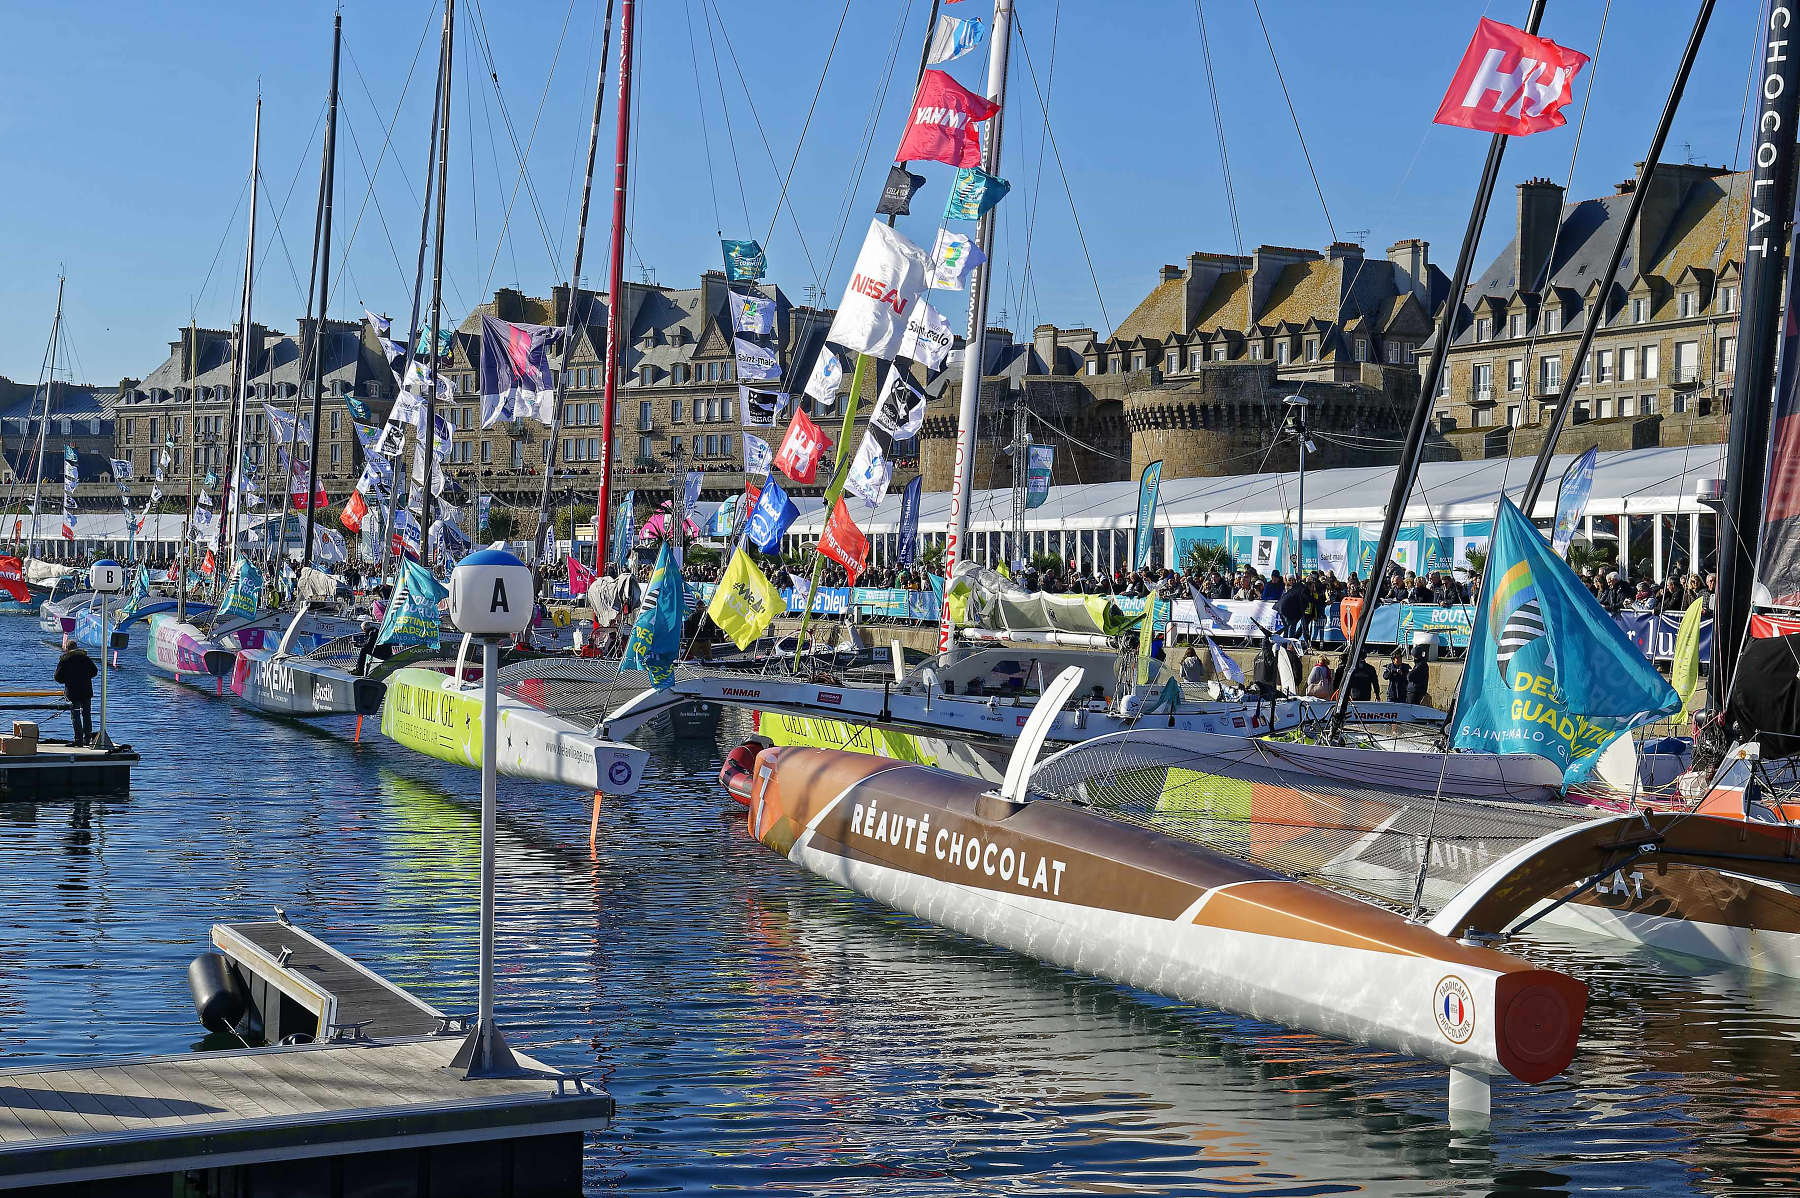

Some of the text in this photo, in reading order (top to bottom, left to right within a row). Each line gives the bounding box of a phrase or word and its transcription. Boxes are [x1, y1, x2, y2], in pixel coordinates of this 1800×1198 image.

[1749, 6, 1792, 258] CHOCOLAT
[106, 570, 114, 584] B
[490, 578, 509, 613] A
[791, 589, 847, 613] frace bleu
[254, 660, 295, 699] ARKEMA
[722, 687, 761, 698] YANMAR
[417, 687, 455, 728] VILLAGE
[1353, 712, 1398, 720] YANMAR
[1461, 725, 1545, 742] SAINT-MALO
[850, 800, 1068, 896] RÉAUTÉ CHOCOLAT
[1439, 980, 1469, 1003] FABRICANT
[1438, 1013, 1471, 1039] CHOCOLATIER
